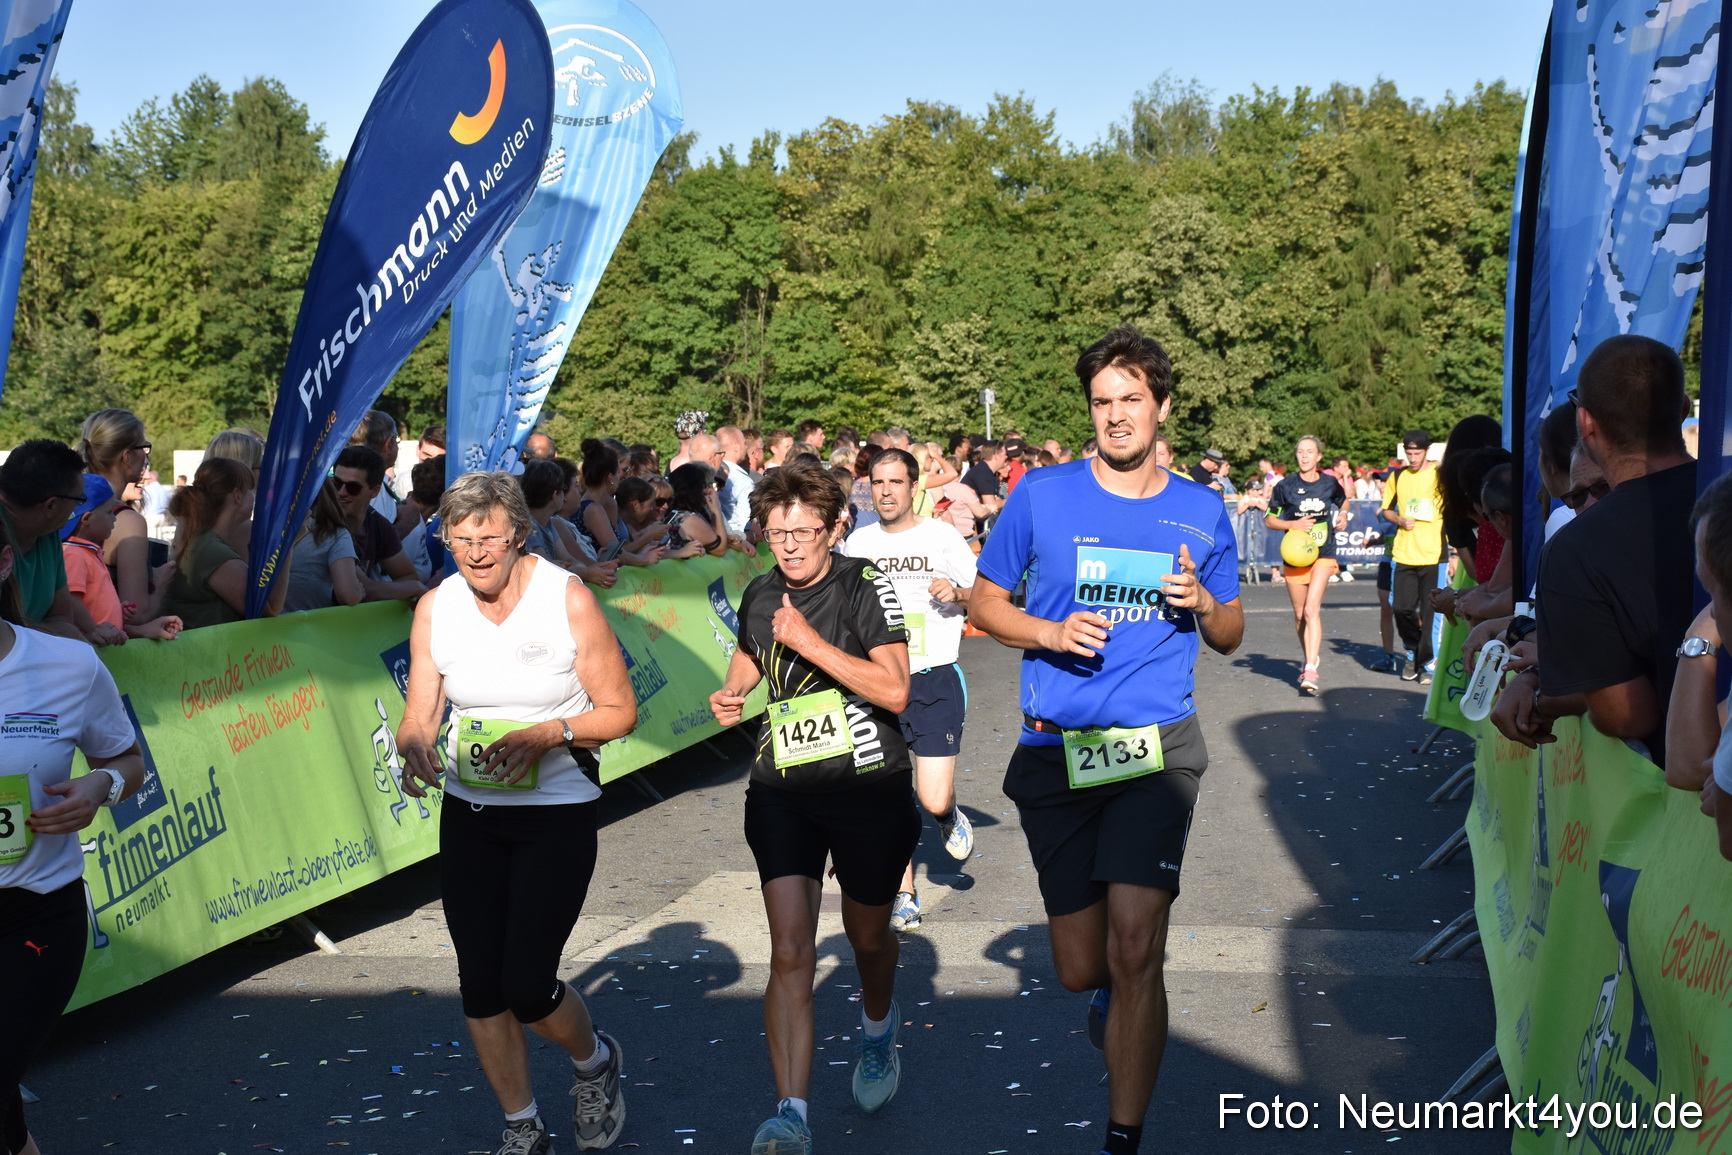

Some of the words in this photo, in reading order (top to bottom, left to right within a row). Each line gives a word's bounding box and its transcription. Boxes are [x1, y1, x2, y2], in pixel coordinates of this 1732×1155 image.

[553, 87, 655, 127] ECHSELSZENE
[402, 240, 448, 304] Druck
[448, 192, 478, 242] und
[479, 117, 535, 199] Medien
[298, 160, 470, 423] Frischmann
[1334, 526, 1380, 545] sch
[875, 556, 934, 573] GRADL
[1079, 583, 1165, 606] MEIKO
[1096, 602, 1180, 631] sports
[181, 653, 243, 719] Gesunde
[243, 644, 295, 687] Firmen
[221, 703, 272, 755] laufen
[265, 669, 325, 731] länger!
[1, 725, 60, 736] NeuerMarkt
[780, 714, 836, 747] 1424
[788, 744, 812, 754] Schmidt
[812, 741, 831, 749] Maria
[1077, 737, 1149, 771] 2133
[97, 765, 226, 900] firmenlauf
[116, 876, 171, 933] neumarkt
